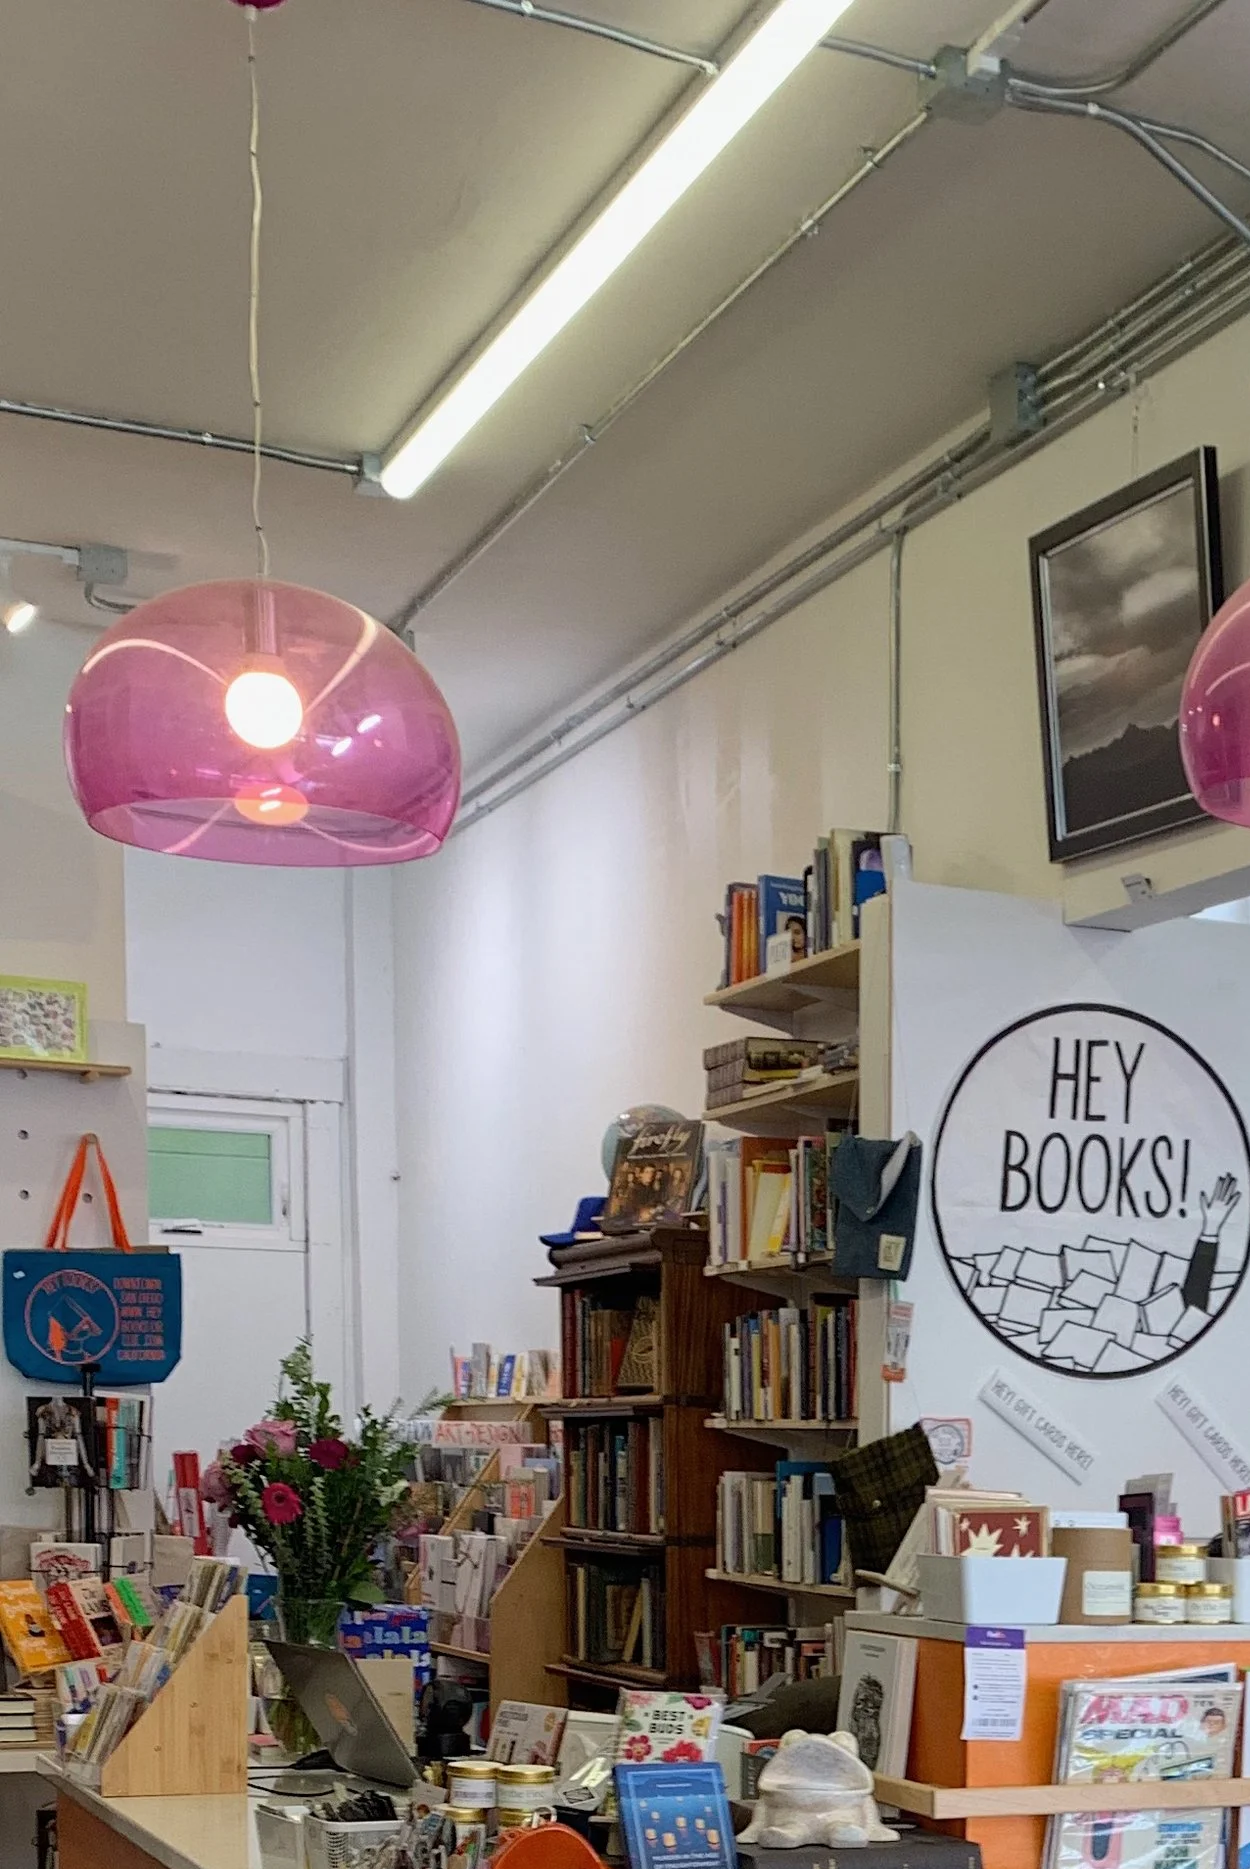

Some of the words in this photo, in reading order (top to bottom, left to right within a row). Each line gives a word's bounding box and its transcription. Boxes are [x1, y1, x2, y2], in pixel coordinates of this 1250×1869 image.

[1048, 1037, 1146, 1124] HEY
[1000, 1130, 1191, 1218] BOOKS!
[990, 1380, 1015, 1407] HEY!
[1013, 1399, 1037, 1423] GIFT
[1034, 1417, 1066, 1449] CARDS
[1063, 1439, 1095, 1471] HERE!
[1167, 1384, 1190, 1412] HEY!
[1187, 1406, 1209, 1431] GIFT
[1203, 1426, 1232, 1461] CARDS
[649, 1723, 685, 1735] BUDS
[652, 1709, 686, 1722] BEST
[1079, 1728, 1184, 1741] SPECIAL
[1080, 1695, 1188, 1725] MAD
